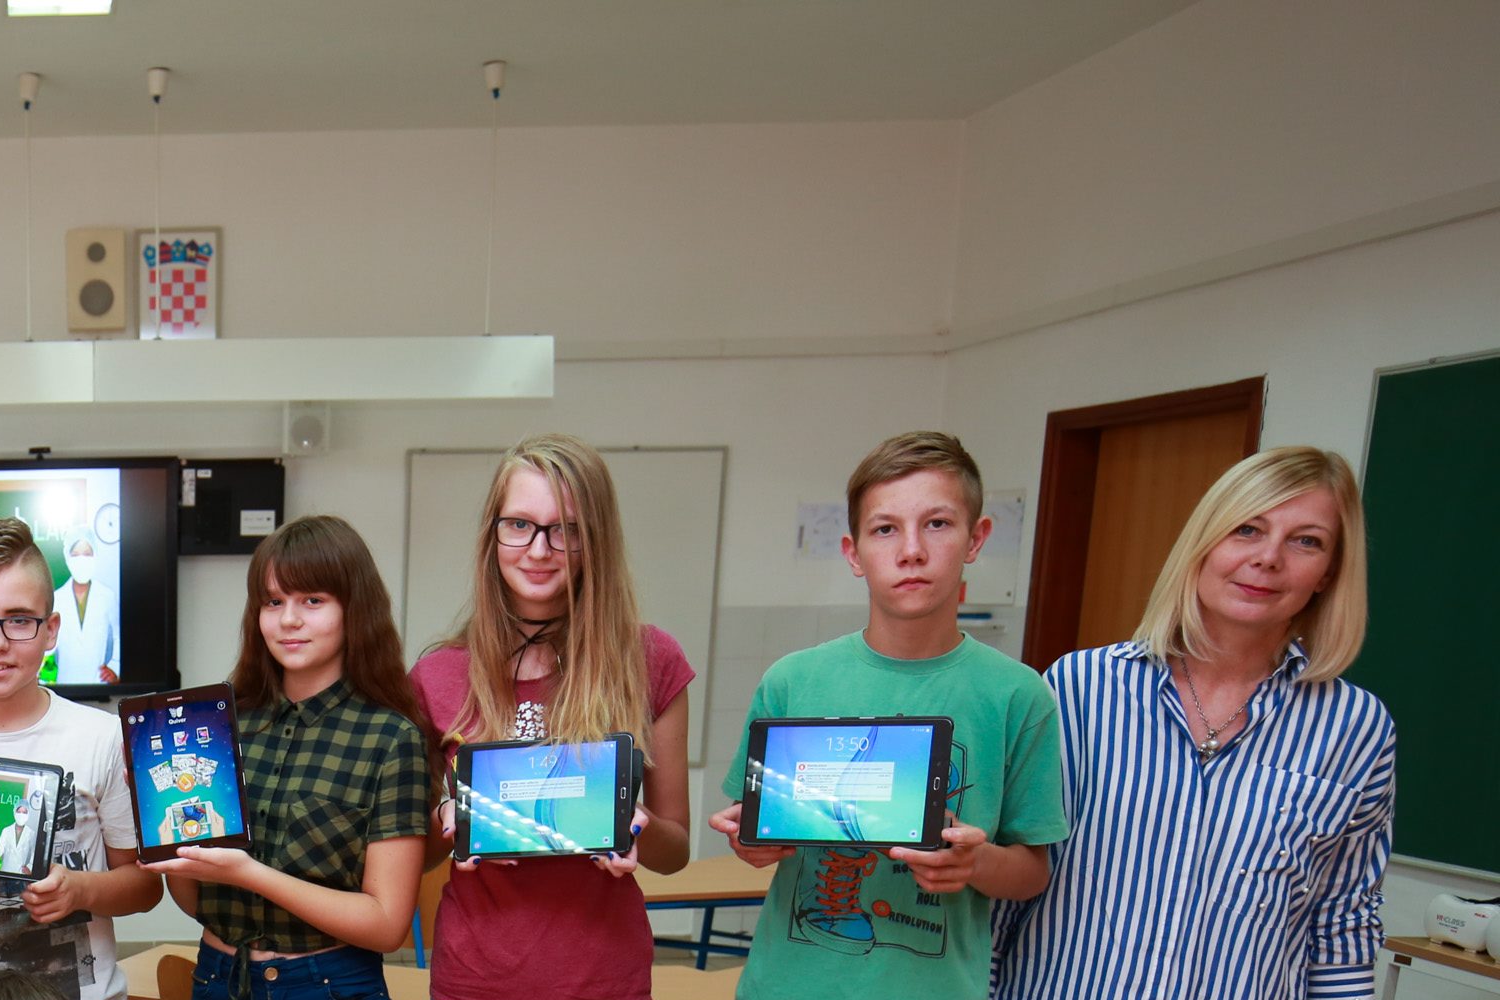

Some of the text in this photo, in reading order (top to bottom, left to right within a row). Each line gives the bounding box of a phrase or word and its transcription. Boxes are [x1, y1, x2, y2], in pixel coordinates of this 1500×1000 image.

[168, 717, 187, 725] Quiver
[825, 737, 870, 752] 13:50
[916, 892, 941, 907] ROLL
[888, 911, 944, 935] REVOLUTION
